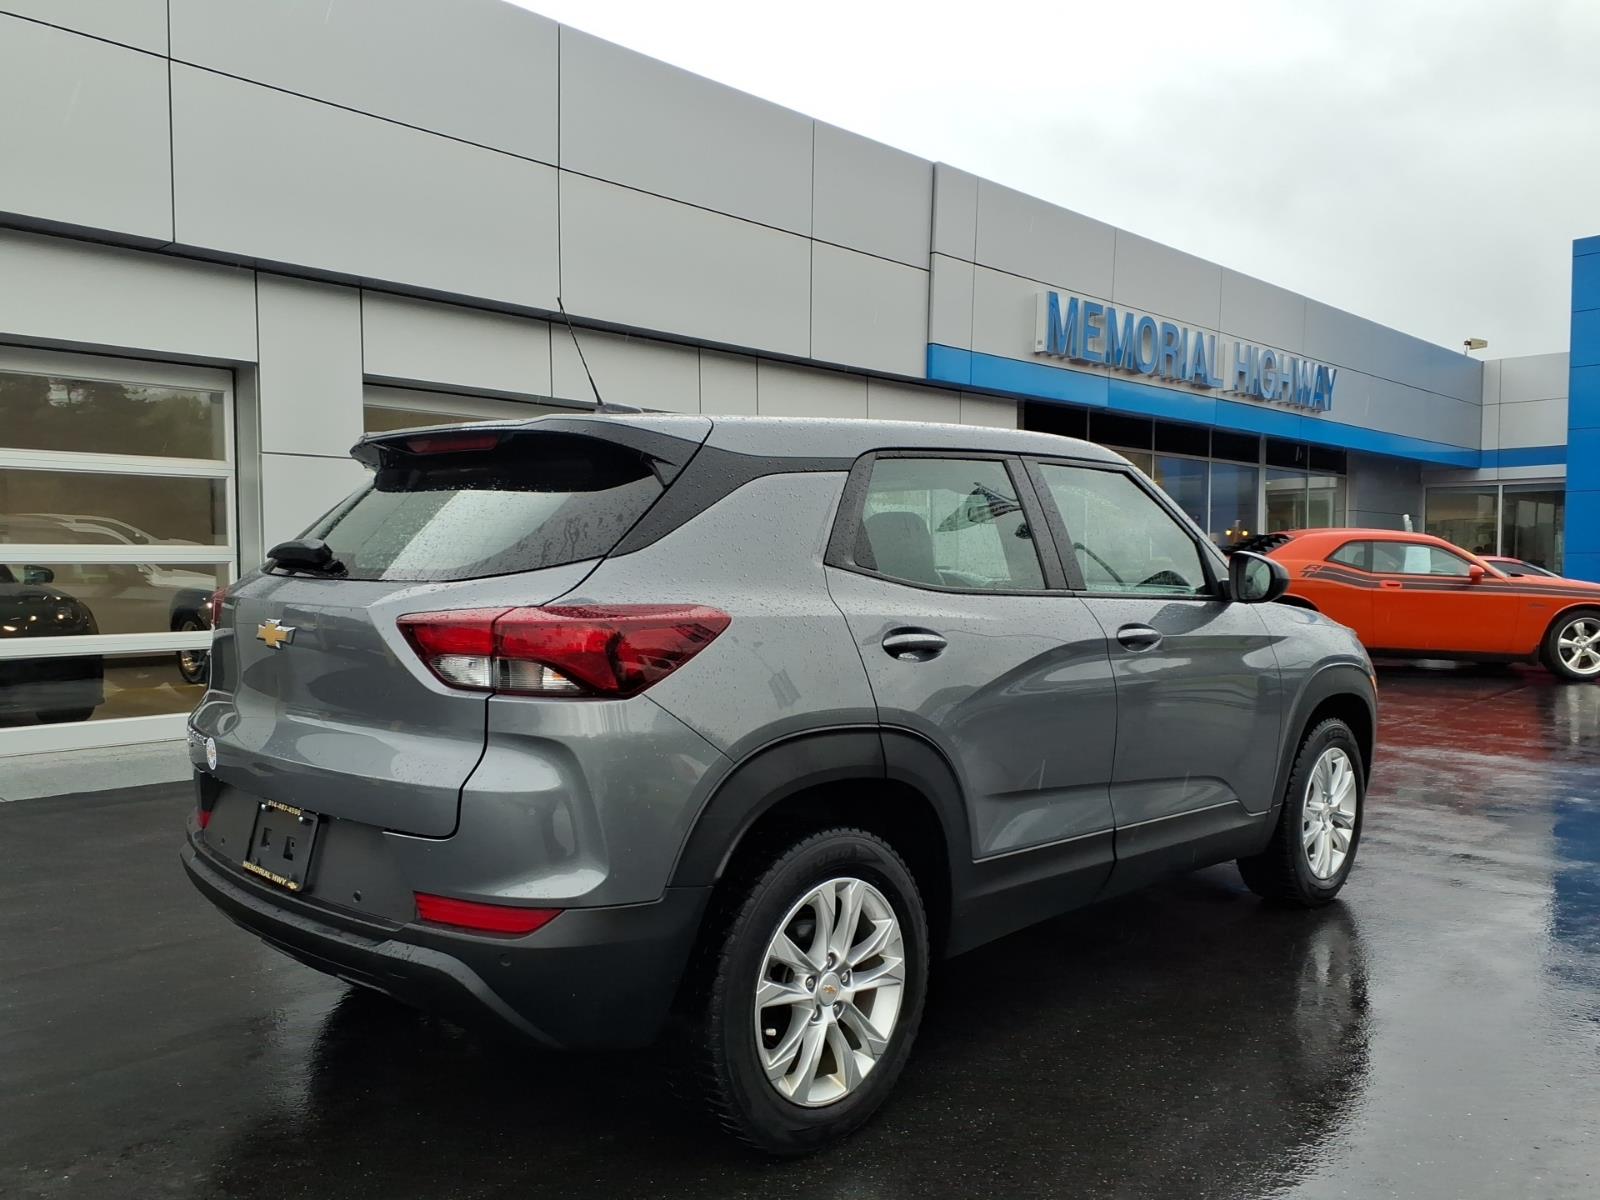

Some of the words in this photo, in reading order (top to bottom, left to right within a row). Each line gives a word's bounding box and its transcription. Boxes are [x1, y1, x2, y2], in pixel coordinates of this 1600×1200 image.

[1045, 291, 1223, 388] MEMORIAL
[1232, 341, 1337, 412] HIGHWAY
[242, 860, 271, 879] MEMORIAL
[272, 873, 287, 885] HWY
